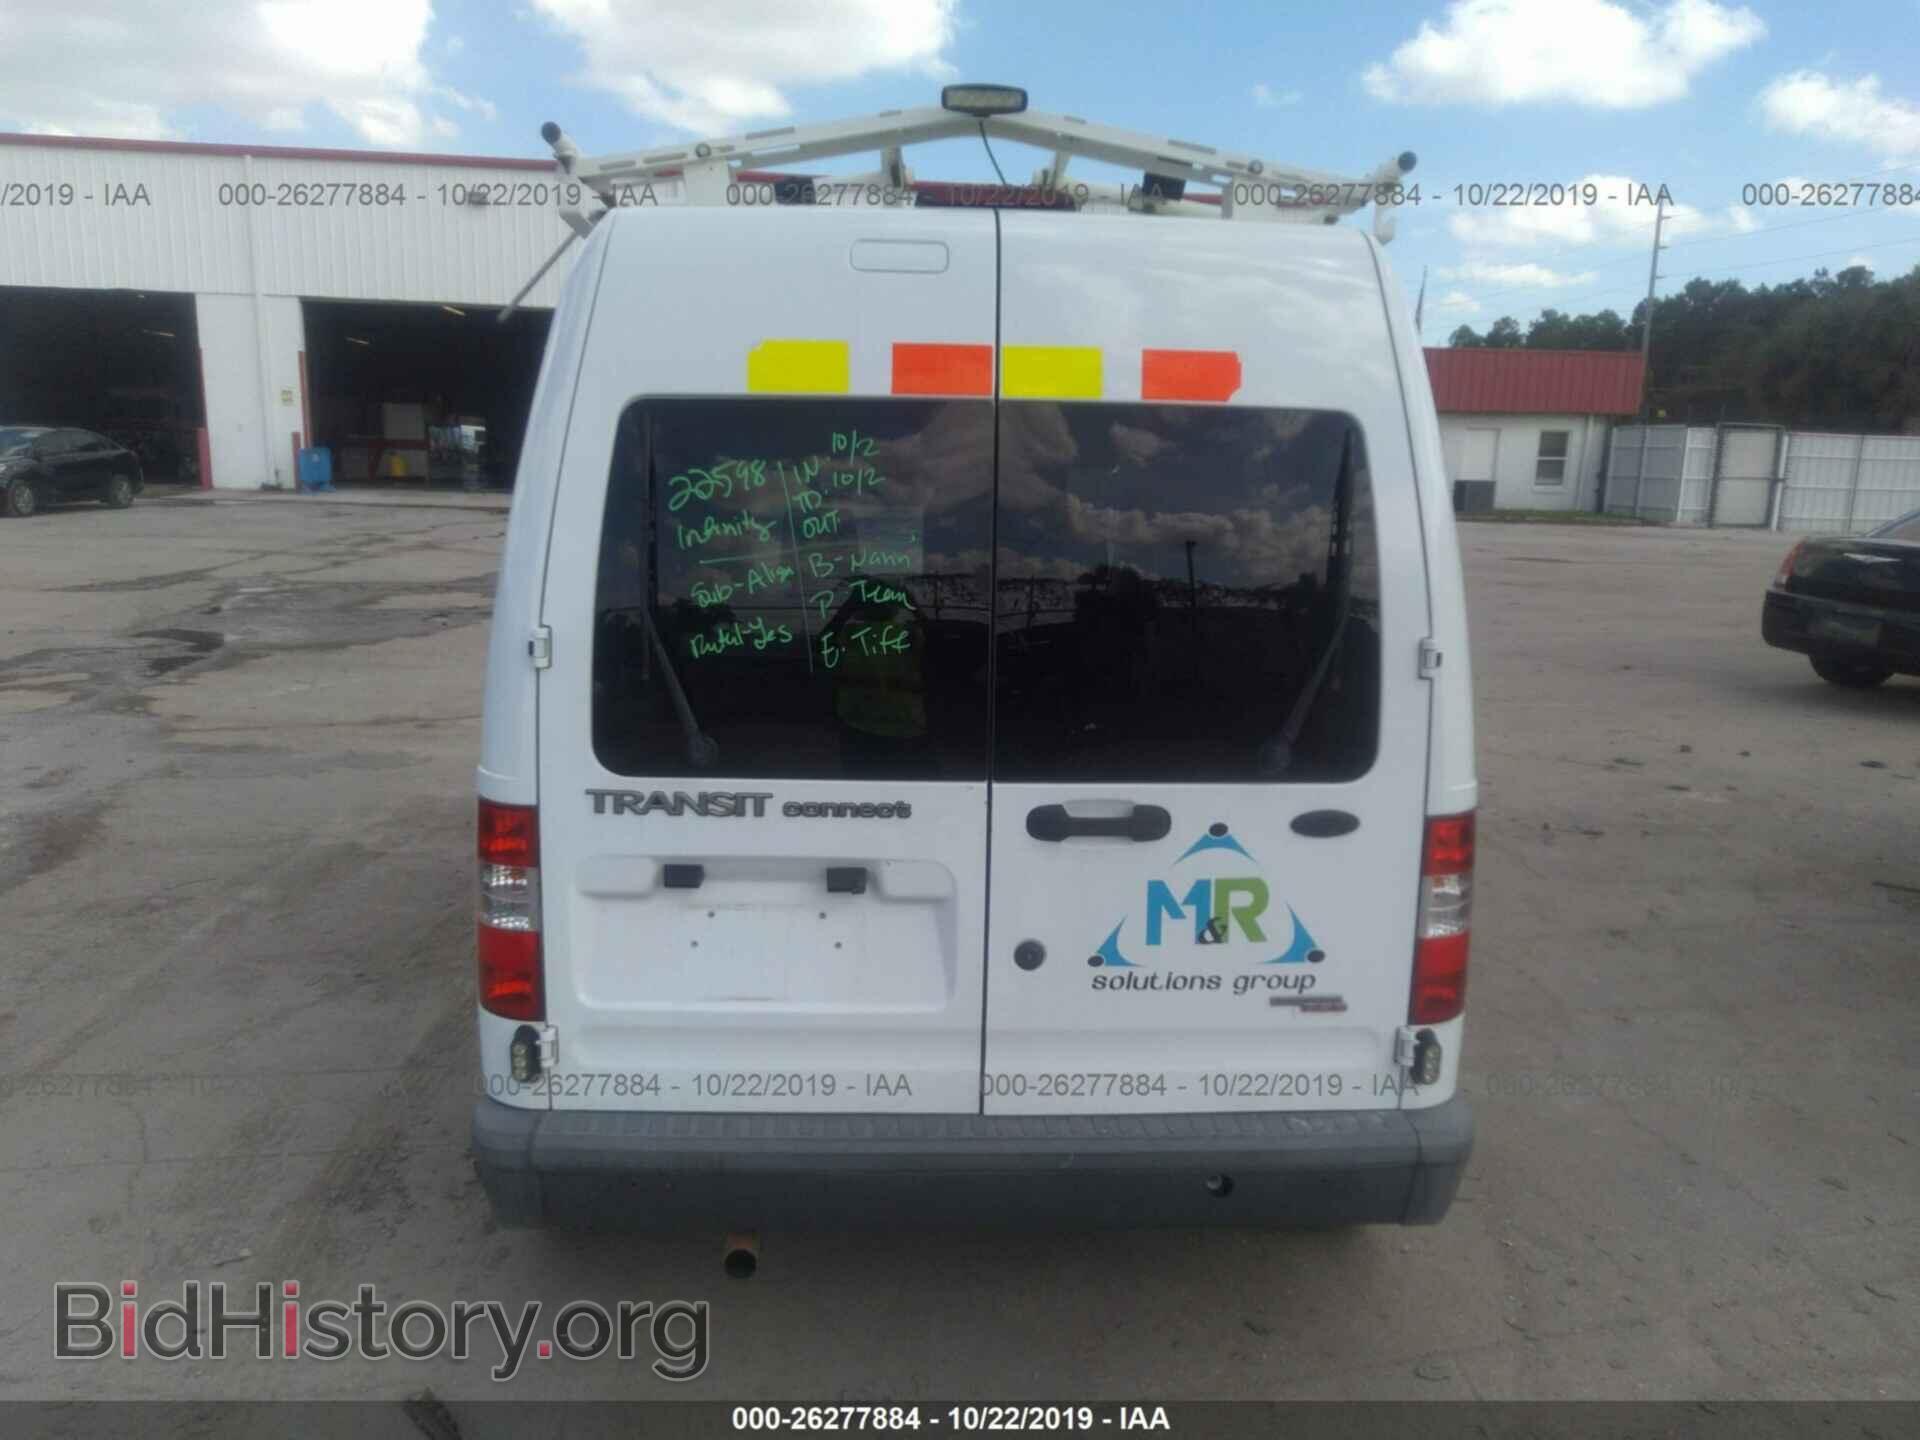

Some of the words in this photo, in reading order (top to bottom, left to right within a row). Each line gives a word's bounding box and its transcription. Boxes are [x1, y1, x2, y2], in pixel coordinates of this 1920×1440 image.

[668, 459, 766, 511] 22598
[584, 788, 774, 818] TRANSIT
[1145, 876, 1270, 946] M&R
[1091, 971, 1222, 991] solutions
[1232, 973, 1316, 996] group
